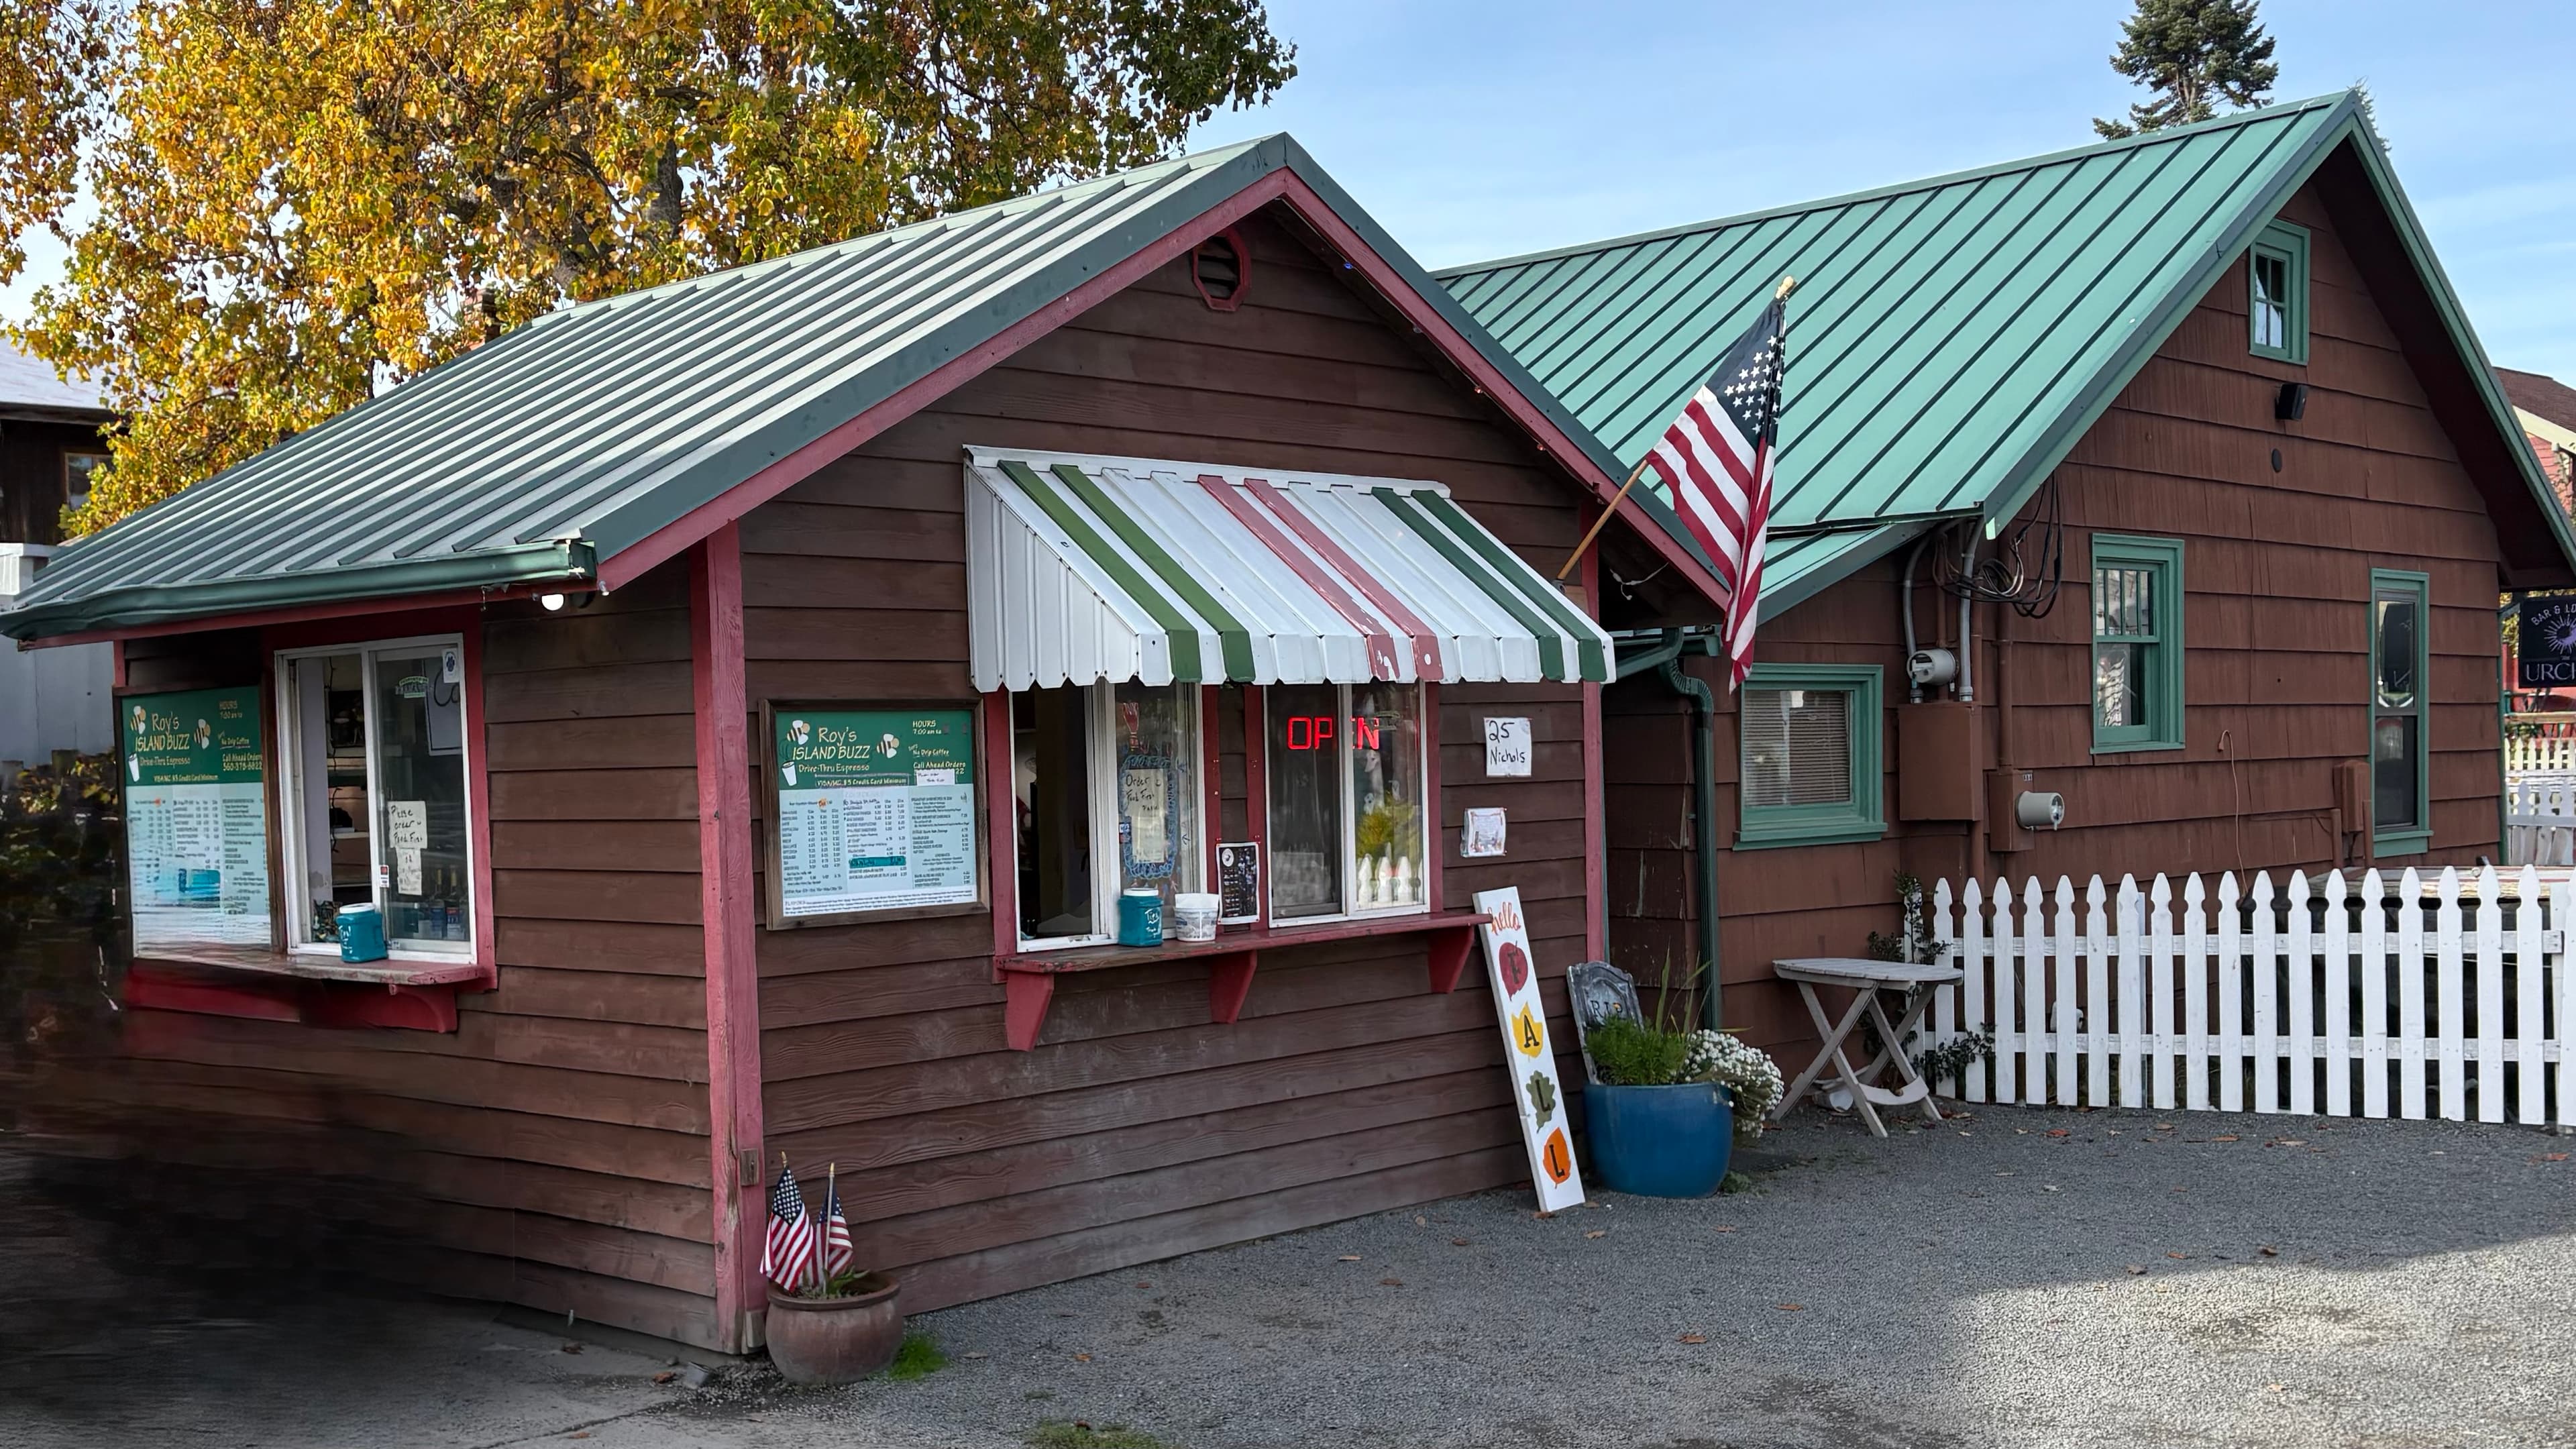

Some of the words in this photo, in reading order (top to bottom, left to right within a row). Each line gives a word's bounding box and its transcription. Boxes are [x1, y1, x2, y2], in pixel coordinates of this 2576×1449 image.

[2531, 609, 2552, 625] BAR
[152, 711, 179, 735] Roy's
[912, 720, 936, 728] HOURS
[1489, 720, 1515, 743] 25
[136, 735, 165, 752] ISLAND
[166, 733, 191, 751] BUZZ
[818, 727, 857, 746] Roy's
[1288, 716, 1380, 750] OPN
[792, 746, 836, 760] ISLAND
[838, 745, 871, 759] BUZZ
[932, 748, 950, 757] Coffee
[1491, 746, 1525, 765] Nichols
[798, 763, 835, 773] Drive-Thru
[836, 763, 870, 774] Espresso
[945, 760, 966, 768] Orders
[1126, 774, 1150, 787] Order
[1487, 902, 1521, 935] hello
[1590, 1000, 1623, 1020] RIP
